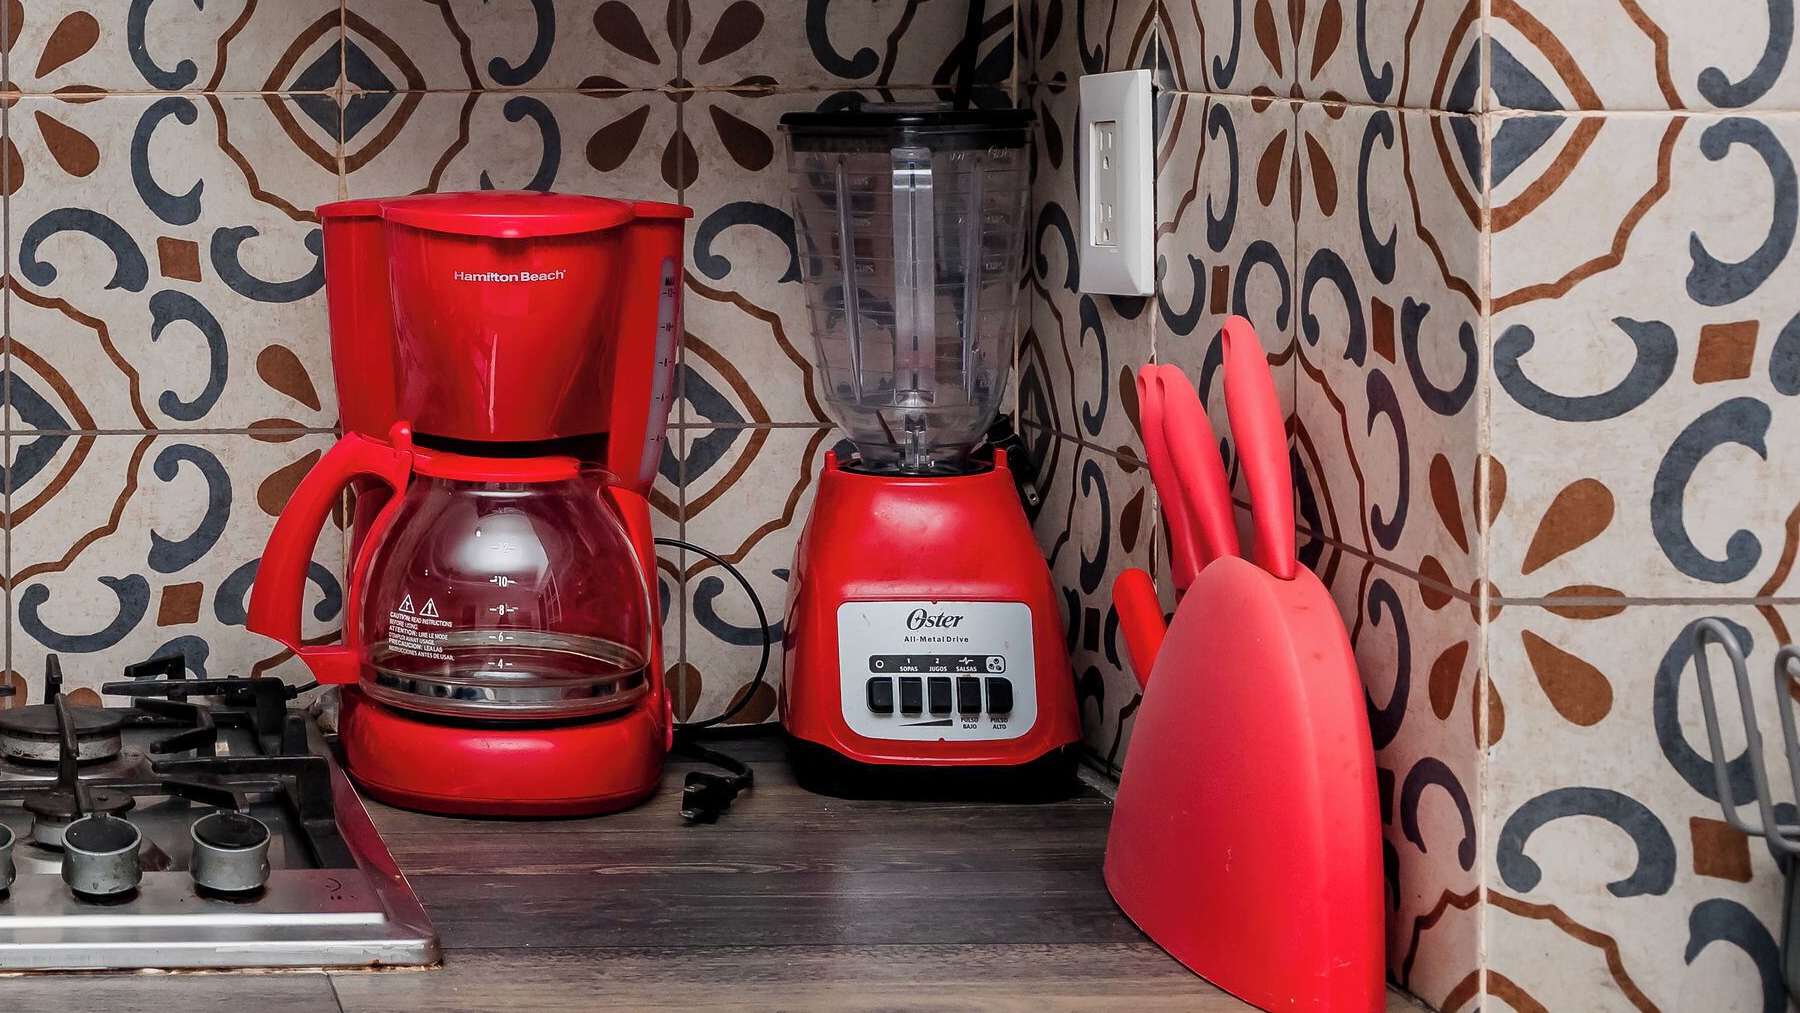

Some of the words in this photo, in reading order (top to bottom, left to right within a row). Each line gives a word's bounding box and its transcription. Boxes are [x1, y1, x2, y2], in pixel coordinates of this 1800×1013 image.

[454, 271, 518, 282] Hamilton
[422, 618, 452, 627] INSTRUCTIONS
[906, 608, 963, 630] Oster
[389, 626, 417, 636] ATTENTION:
